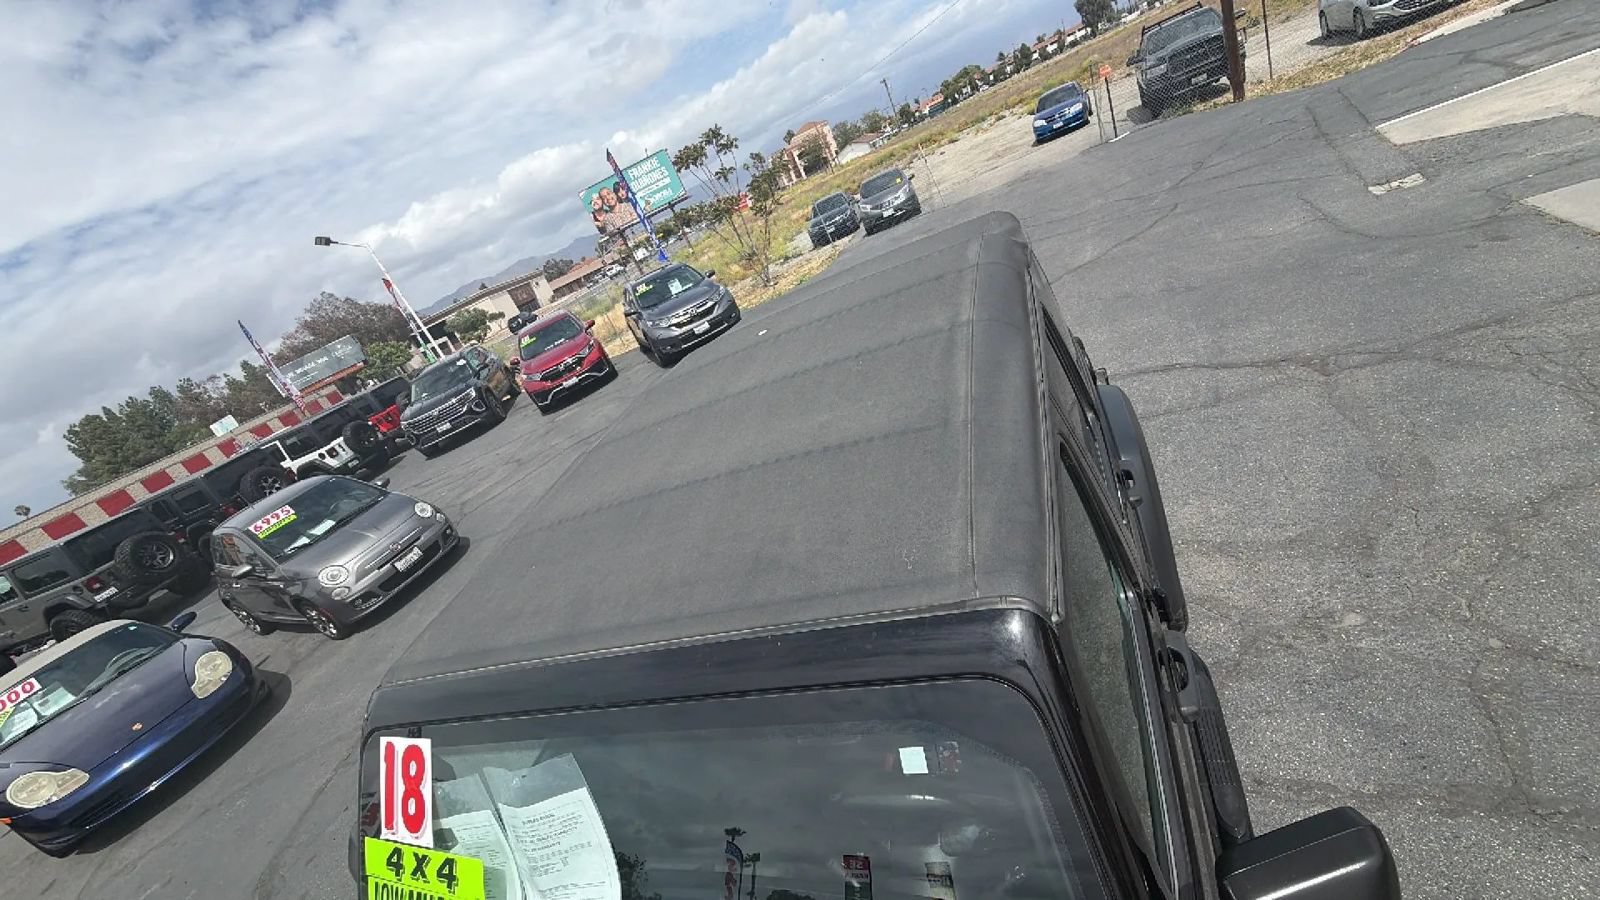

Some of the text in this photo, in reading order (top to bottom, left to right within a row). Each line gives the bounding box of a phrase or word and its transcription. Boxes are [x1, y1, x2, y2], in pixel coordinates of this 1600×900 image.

[628, 157, 660, 180] FRANKIE
[254, 507, 291, 533] 6995
[384, 741, 427, 836] 18
